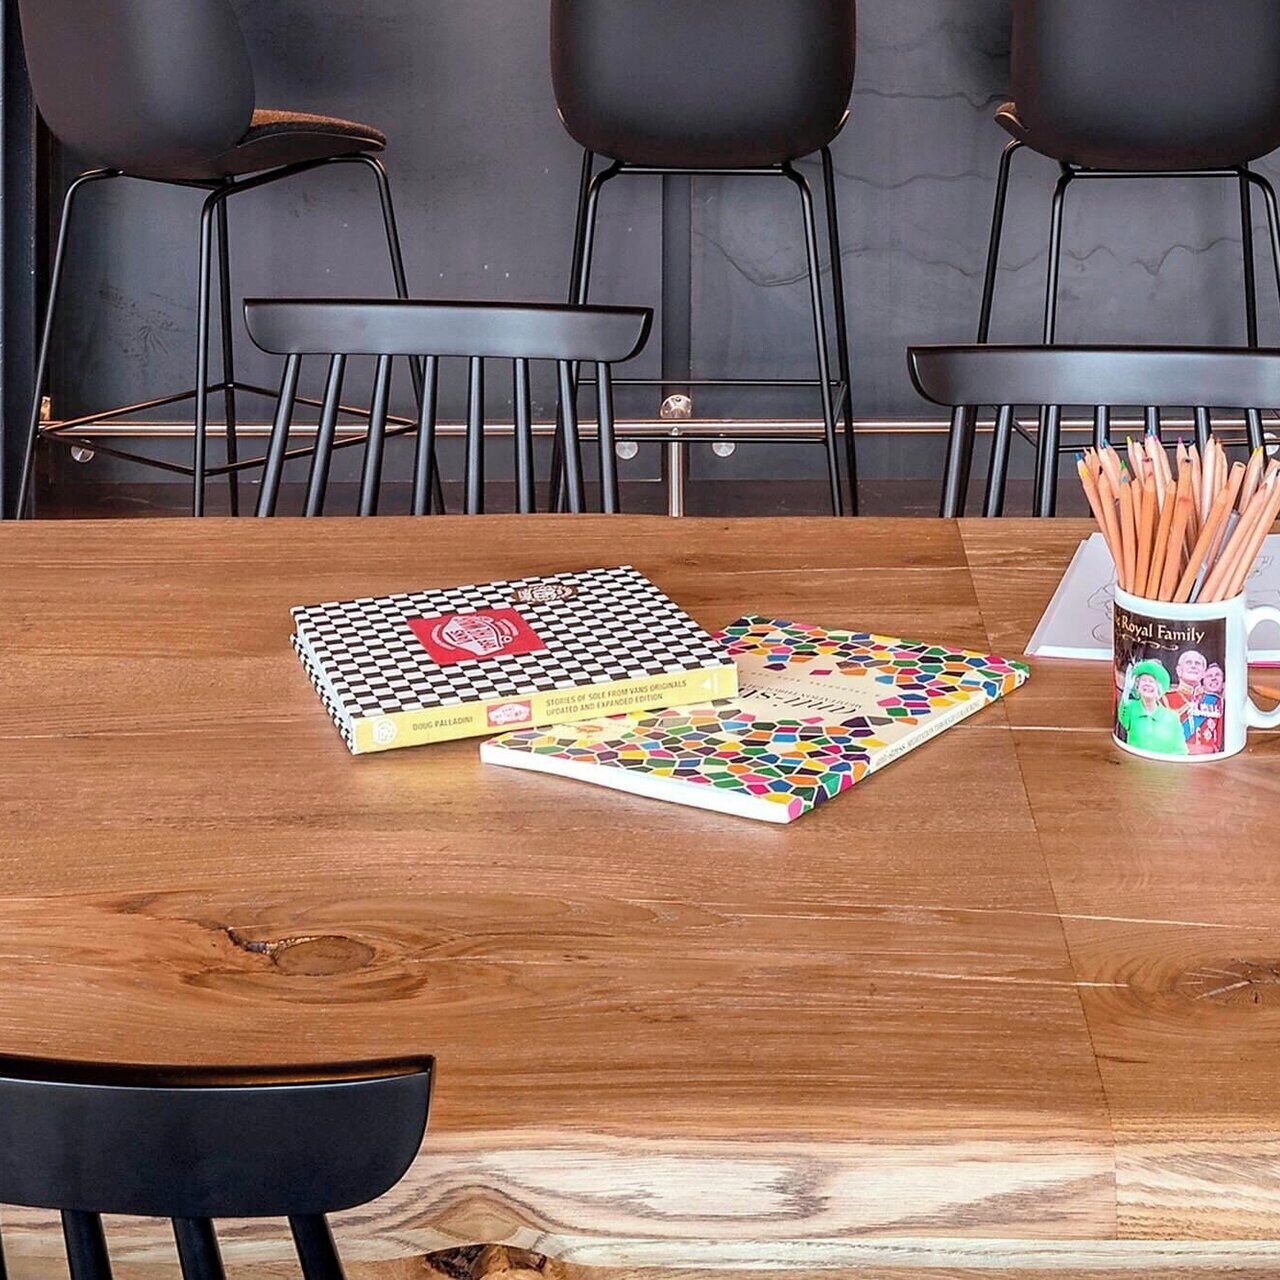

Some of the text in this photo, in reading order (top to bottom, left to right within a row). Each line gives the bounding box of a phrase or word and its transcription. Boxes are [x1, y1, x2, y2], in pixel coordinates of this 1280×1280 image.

[1121, 616, 1153, 639] Royal
[1157, 624, 1205, 645] Family
[546, 680, 687, 707] STORIES OF SOLE FROM VANS ORIGINALS
[546, 693, 663, 716] UPDATED AND EXPANDED EDITION
[412, 715, 473, 731] DOUG PALLADINI
